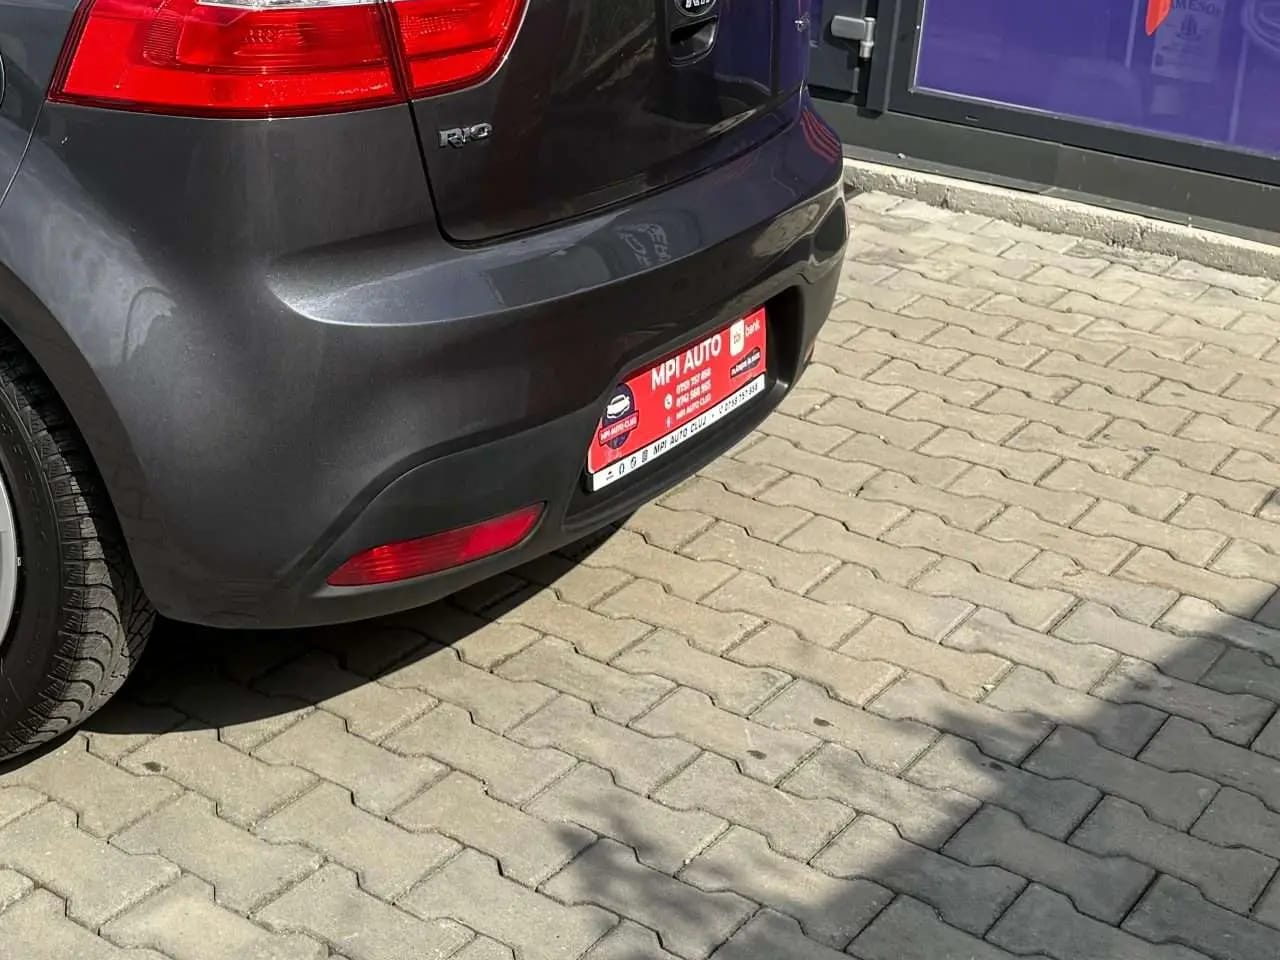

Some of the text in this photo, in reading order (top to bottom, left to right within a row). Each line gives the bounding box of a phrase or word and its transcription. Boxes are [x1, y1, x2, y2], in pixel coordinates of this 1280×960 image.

[439, 123, 492, 148] RIO
[651, 355, 680, 392] MPI
[683, 334, 722, 374] AUTO
